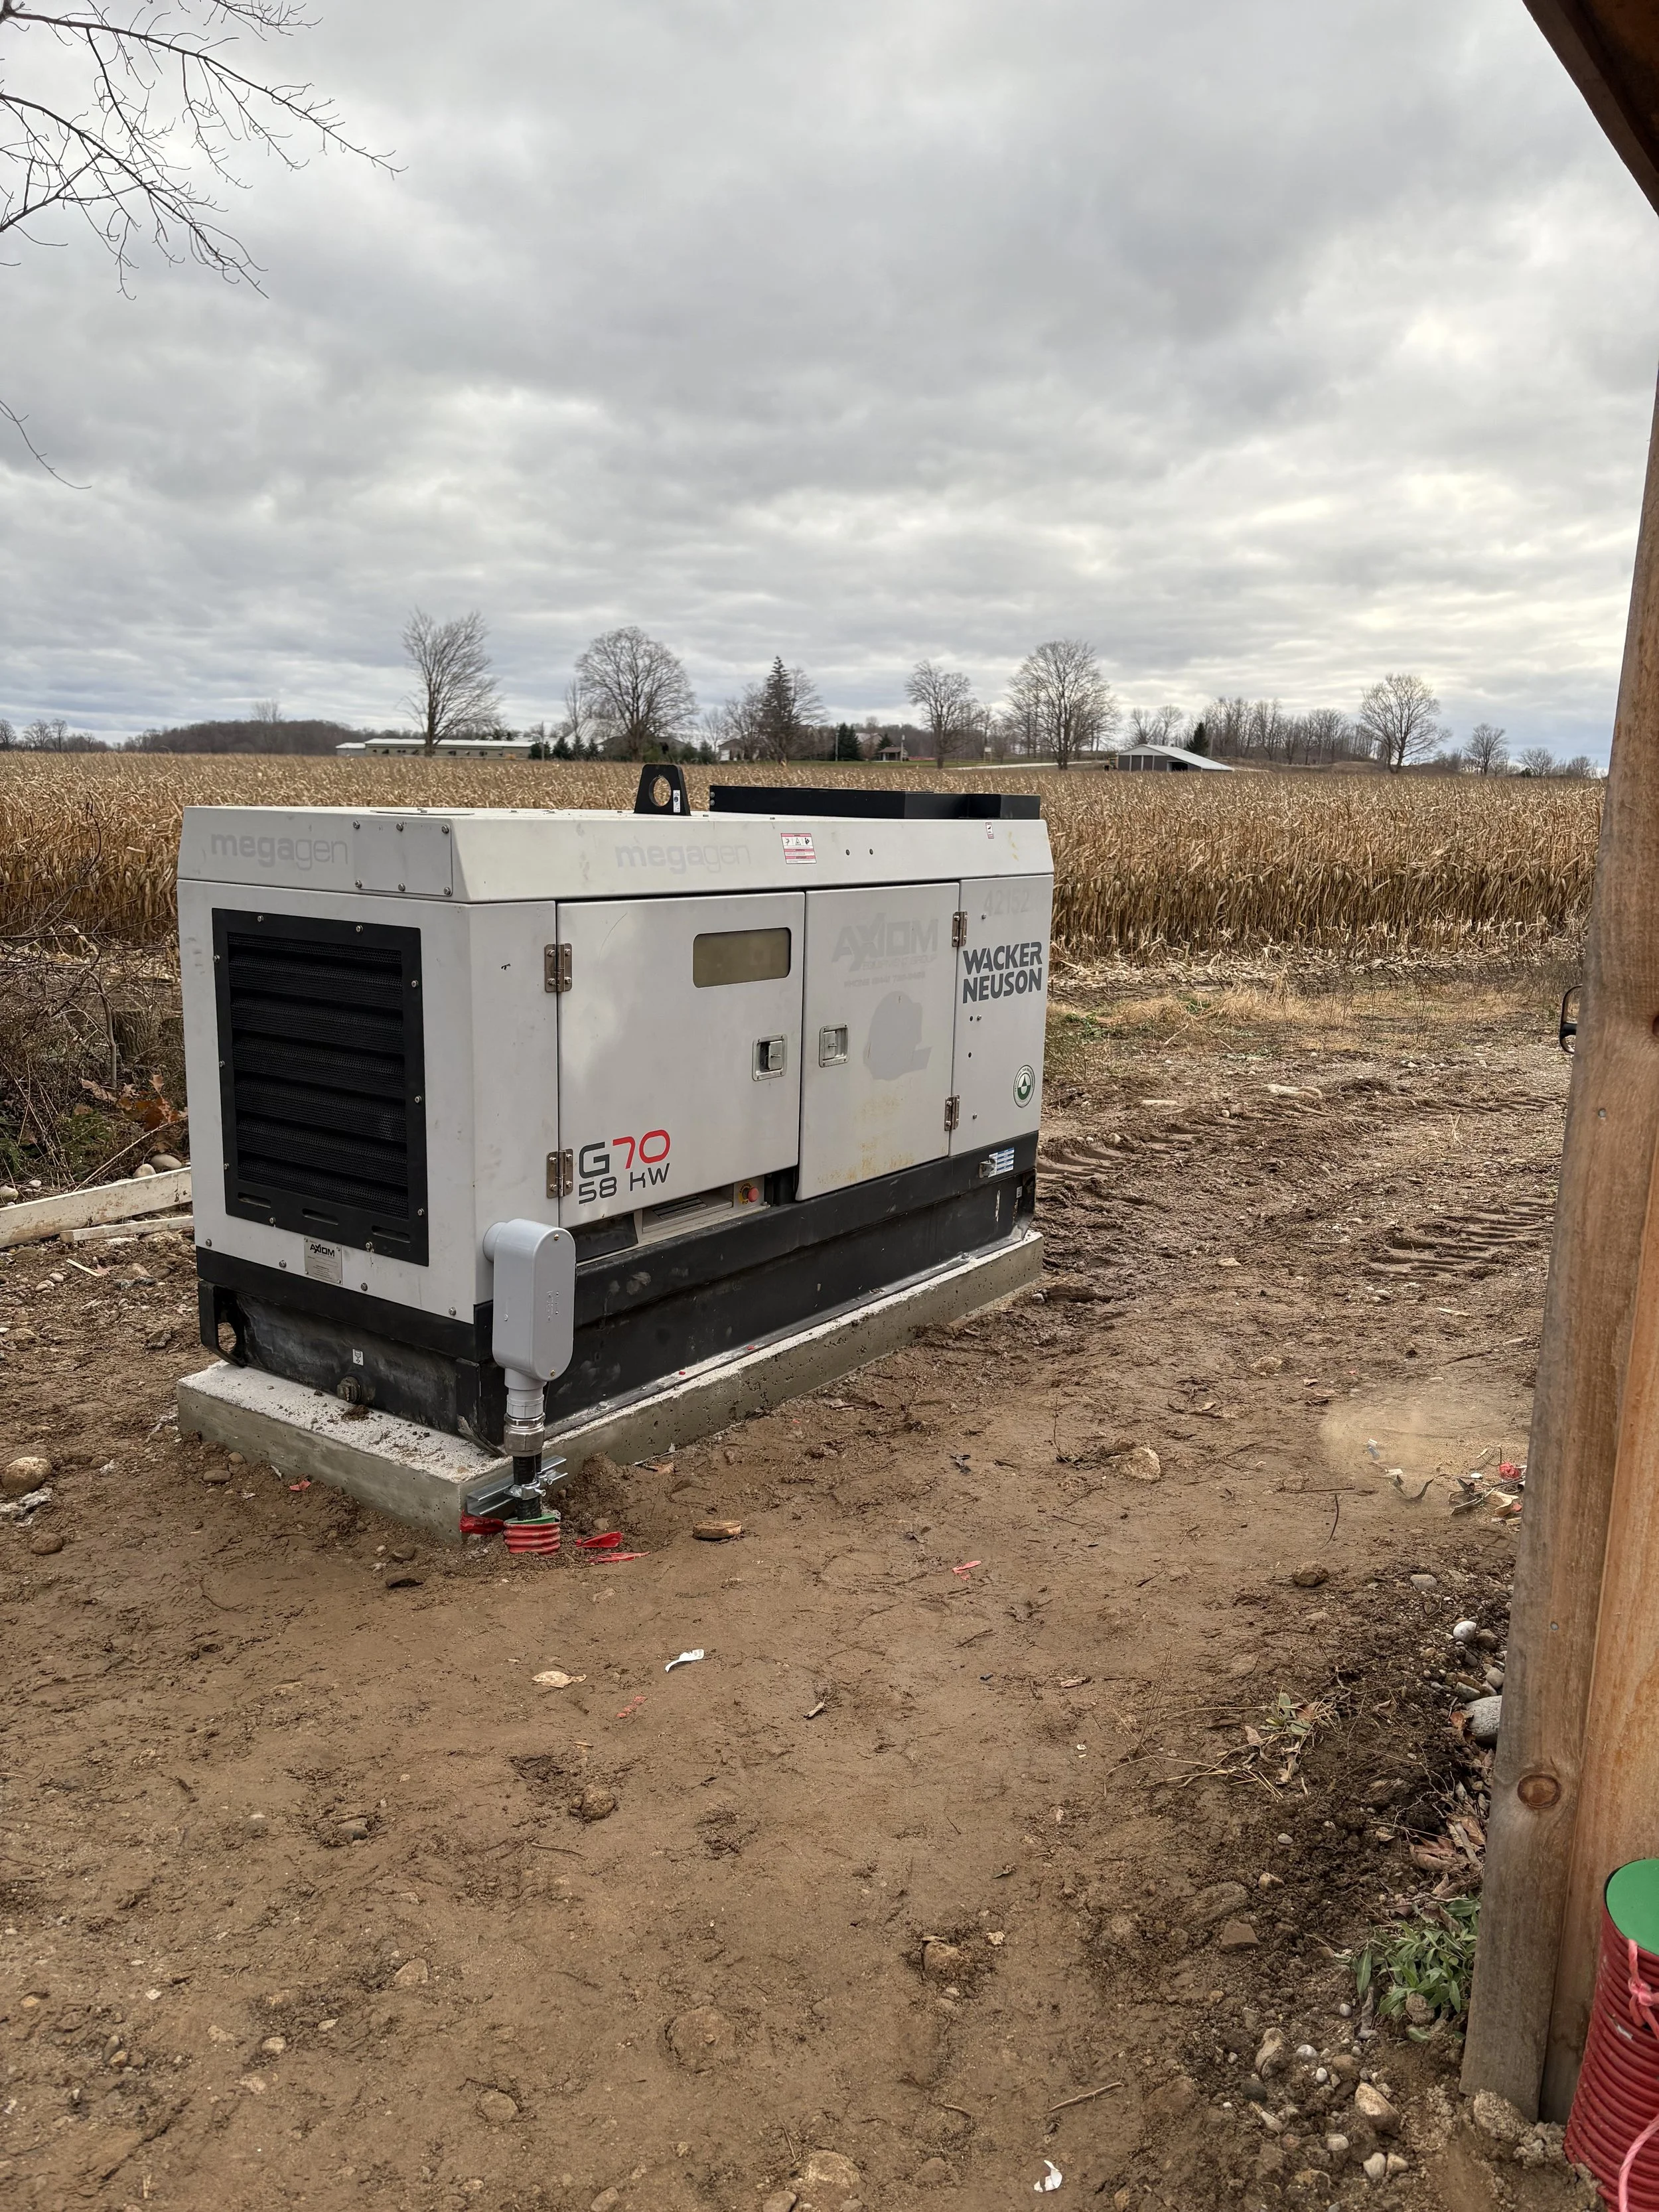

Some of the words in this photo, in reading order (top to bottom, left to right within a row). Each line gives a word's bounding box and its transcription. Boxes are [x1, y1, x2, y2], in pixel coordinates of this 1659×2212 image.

[210, 833, 348, 871] megagen
[614, 844, 752, 875] megagen
[831, 912, 939, 973] AXIOM
[962, 941, 1043, 975] WACKER
[962, 967, 1043, 1004] NEUSON
[579, 1129, 671, 1179] G70
[578, 1176, 617, 1205] 58
[309, 1244, 335, 1257] AXIOM
